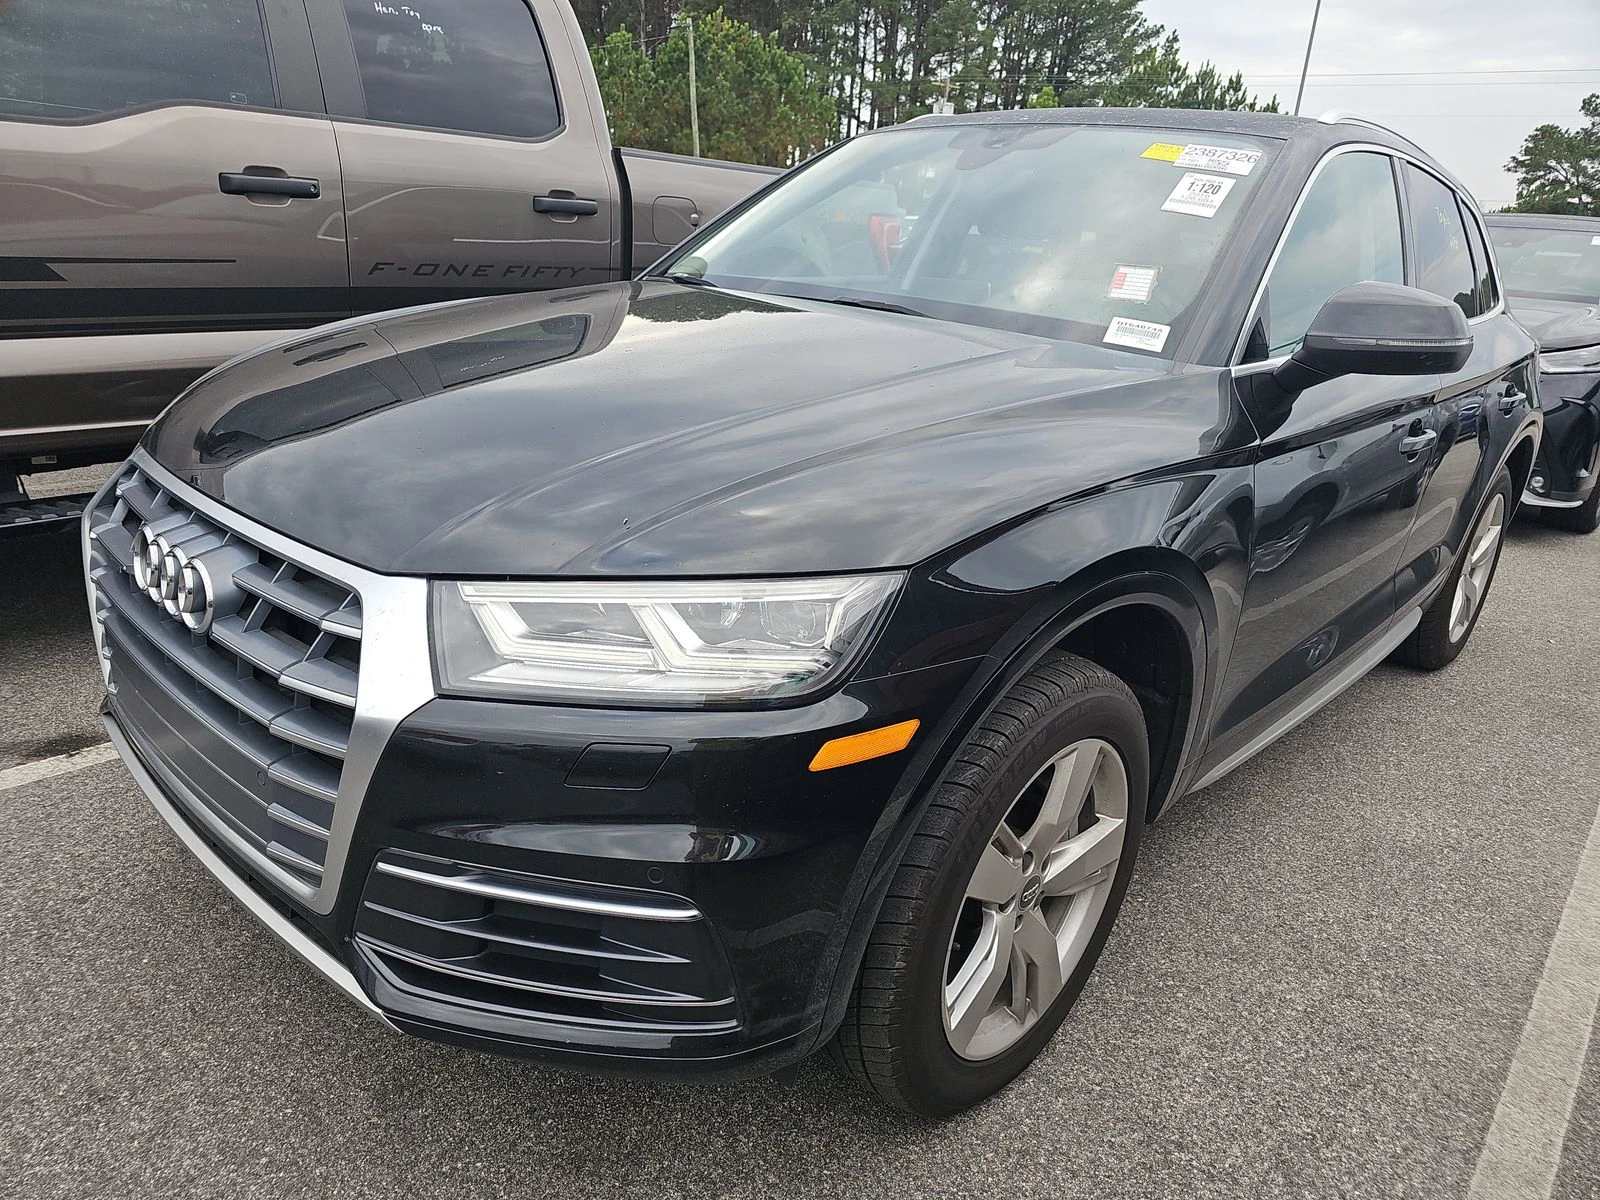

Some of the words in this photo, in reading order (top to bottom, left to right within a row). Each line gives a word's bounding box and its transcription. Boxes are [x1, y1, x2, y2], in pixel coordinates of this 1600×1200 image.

[1185, 147, 1259, 164] 2387326
[368, 262, 495, 278] F-ONE
[502, 265, 586, 279] FIFTY
